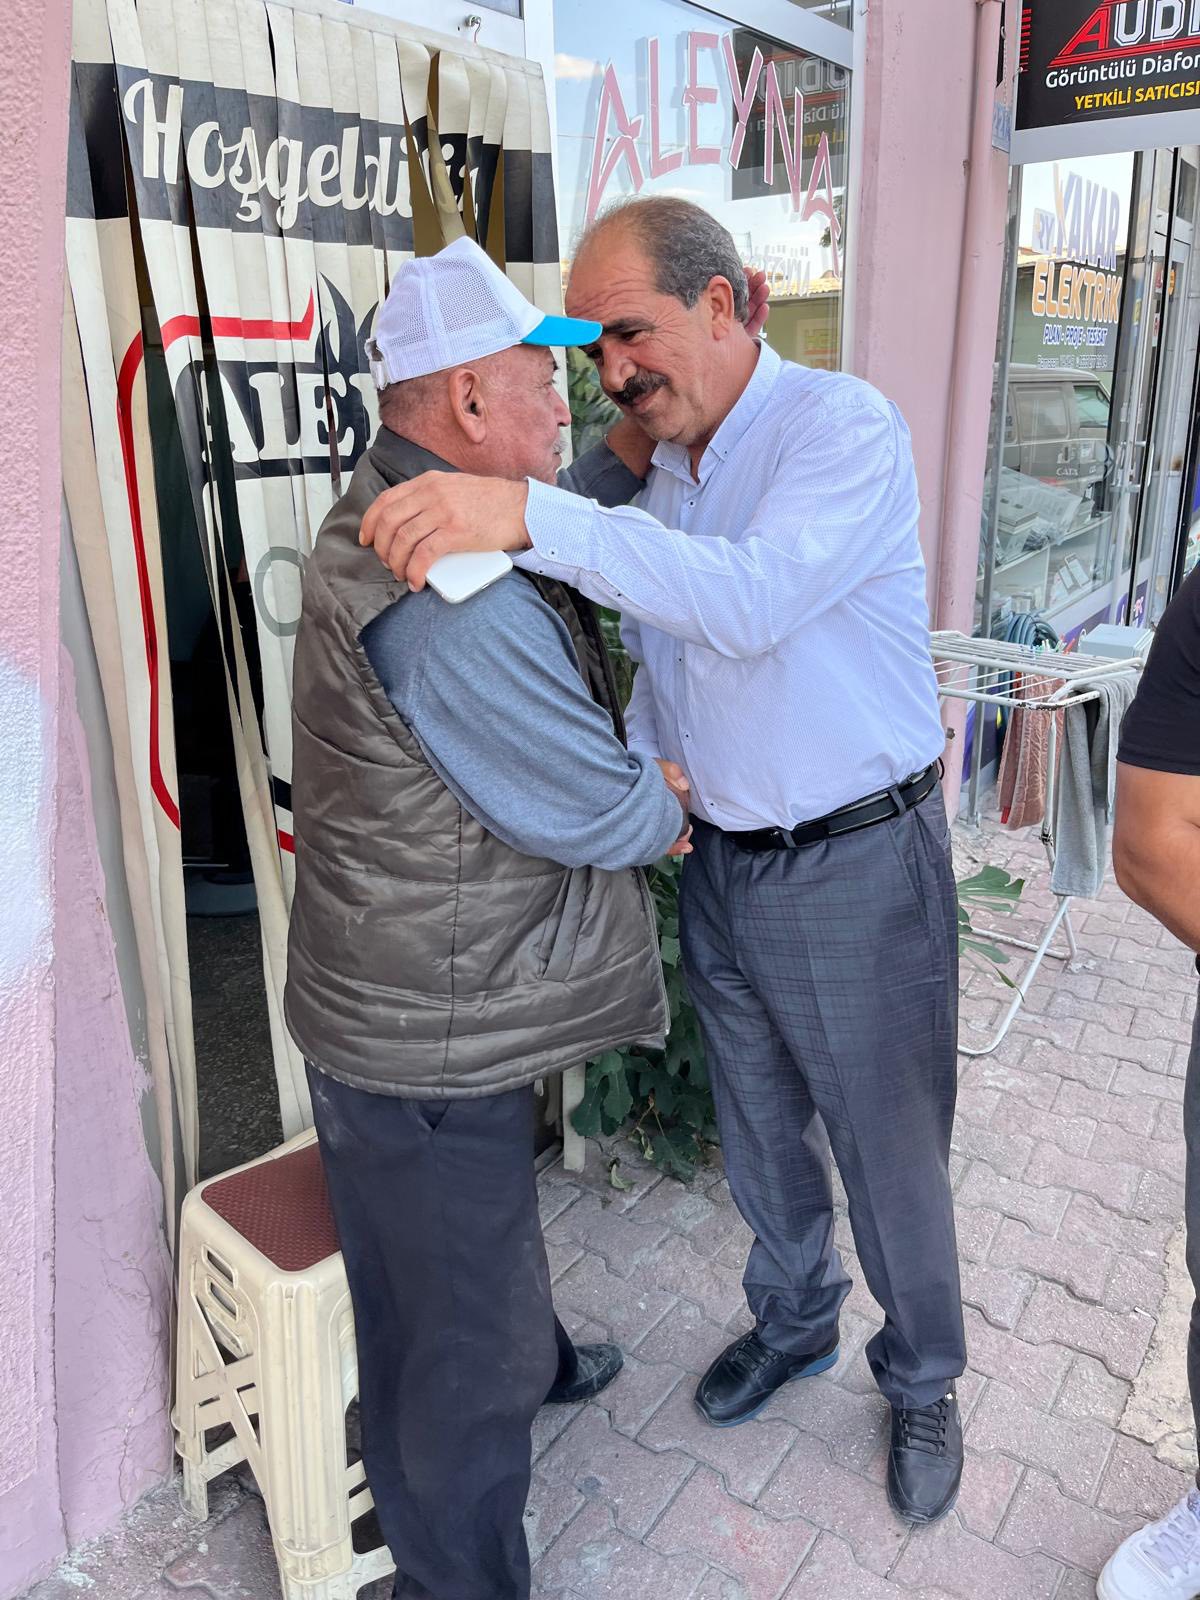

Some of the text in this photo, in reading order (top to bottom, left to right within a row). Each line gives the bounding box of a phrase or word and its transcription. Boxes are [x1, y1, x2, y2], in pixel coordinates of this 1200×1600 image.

[1046, 59, 1136, 88] Görüntülü
[1074, 80, 1200, 109] YETKİLİ SATICISI
[584, 32, 841, 279] ALEYNA
[1053, 163, 1121, 272] YAKAR
